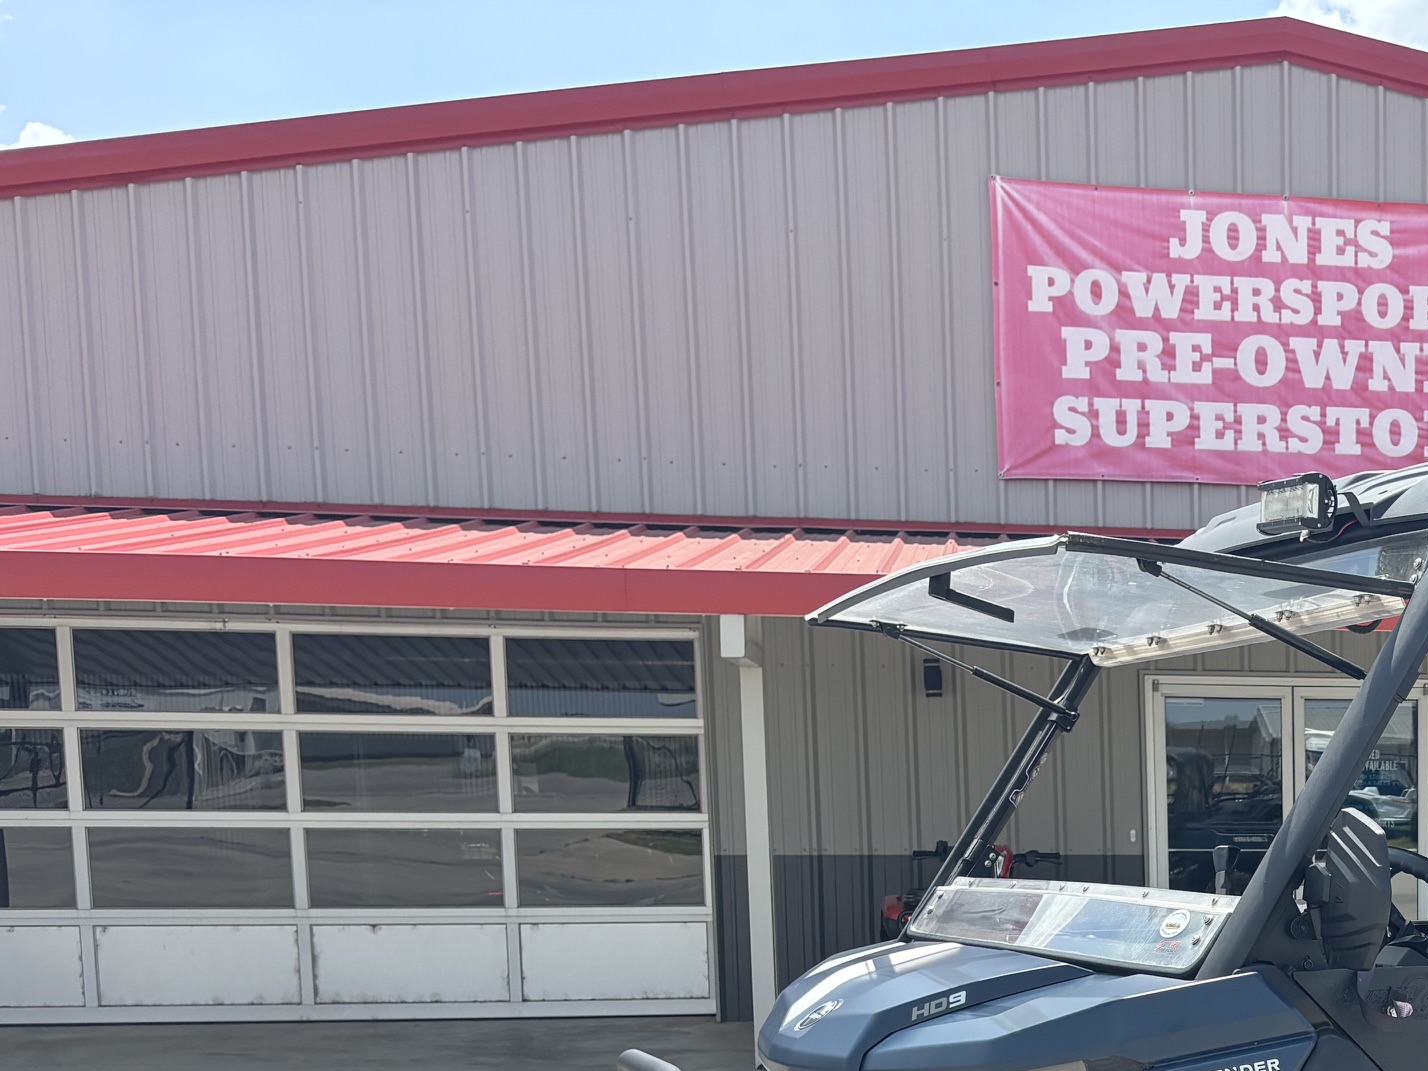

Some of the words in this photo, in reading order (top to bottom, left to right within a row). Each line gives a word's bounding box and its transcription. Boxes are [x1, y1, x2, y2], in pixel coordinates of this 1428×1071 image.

[1168, 208, 1392, 270] JONES
[1363, 760, 1398, 771] VAILABLE
[911, 990, 967, 1021] HD9
